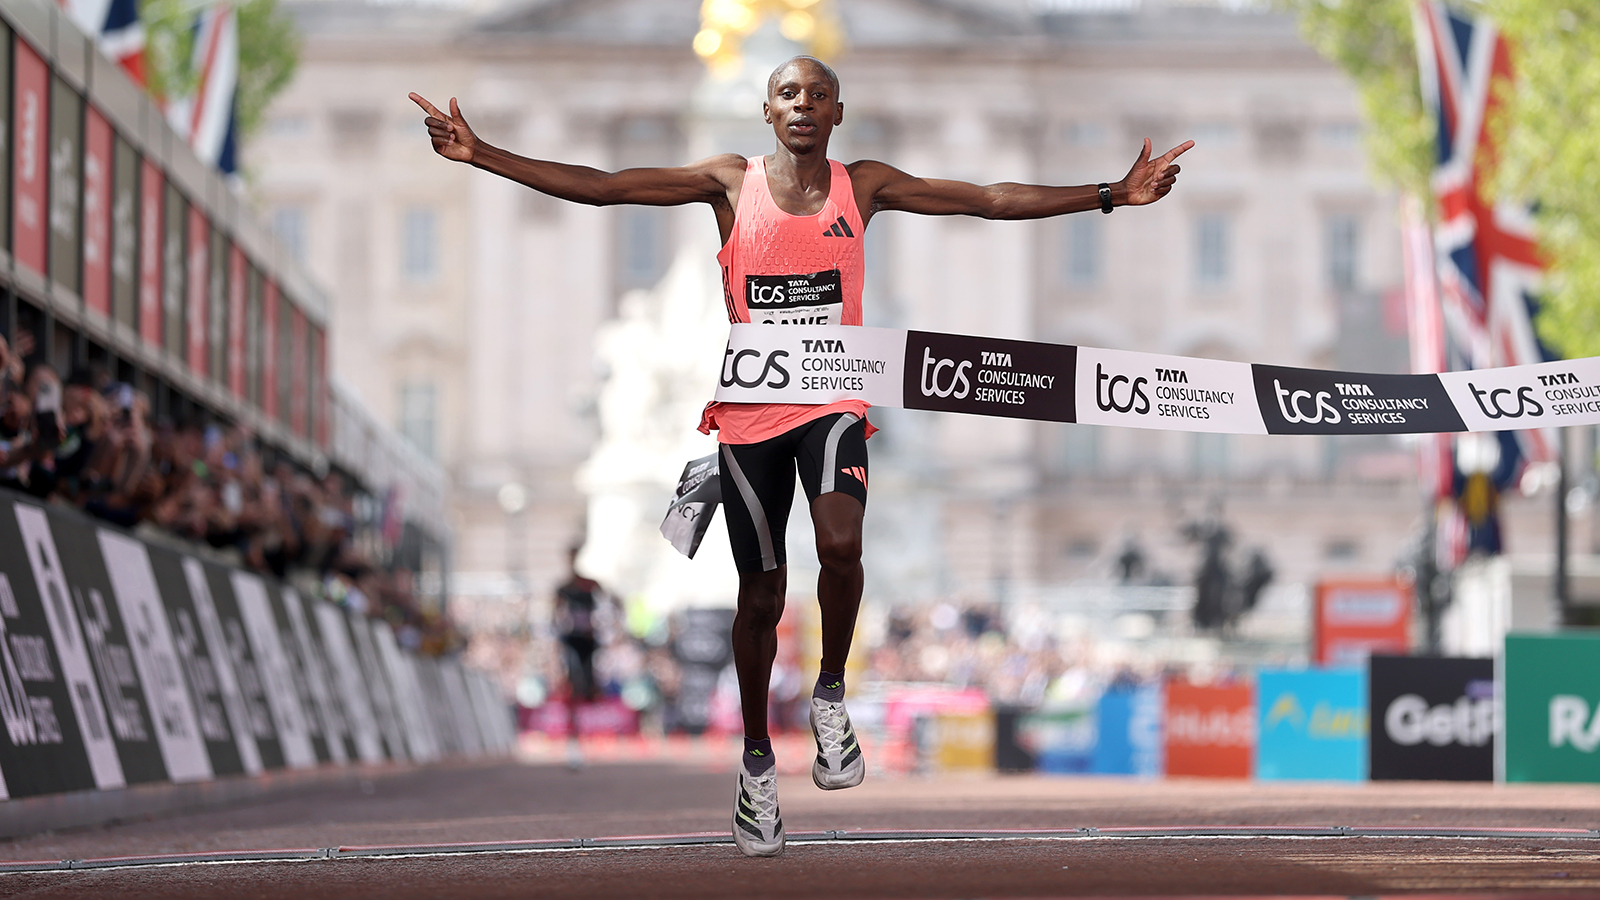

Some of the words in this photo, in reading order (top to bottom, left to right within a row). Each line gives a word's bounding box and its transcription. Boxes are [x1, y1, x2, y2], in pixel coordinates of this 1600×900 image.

[751, 280, 785, 304] tcs
[788, 284, 836, 295] CONSULTANCY
[788, 294, 820, 303] SERVICES
[762, 316, 829, 325] AWE
[802, 339, 846, 353] TATA
[720, 339, 791, 389] tcs
[801, 358, 886, 374] CONSULTANCY
[981, 352, 1012, 368] TATA
[920, 346, 972, 400] tcs
[977, 369, 1056, 390] CONSULTANCY
[1155, 368, 1189, 384] TATA
[1537, 372, 1580, 386] TATA
[801, 376, 864, 391] SERVICES
[1096, 362, 1151, 415] tcs
[1334, 382, 1375, 396] TATA
[975, 388, 1026, 406] SERVICES
[1155, 386, 1235, 406] CONSULTANCY
[1273, 378, 1342, 424] tcs
[1468, 382, 1544, 419] tcs
[1158, 404, 1210, 420] SERVICES
[1342, 396, 1429, 413] CONSULTANCY
[1348, 412, 1407, 425] SERVICES
